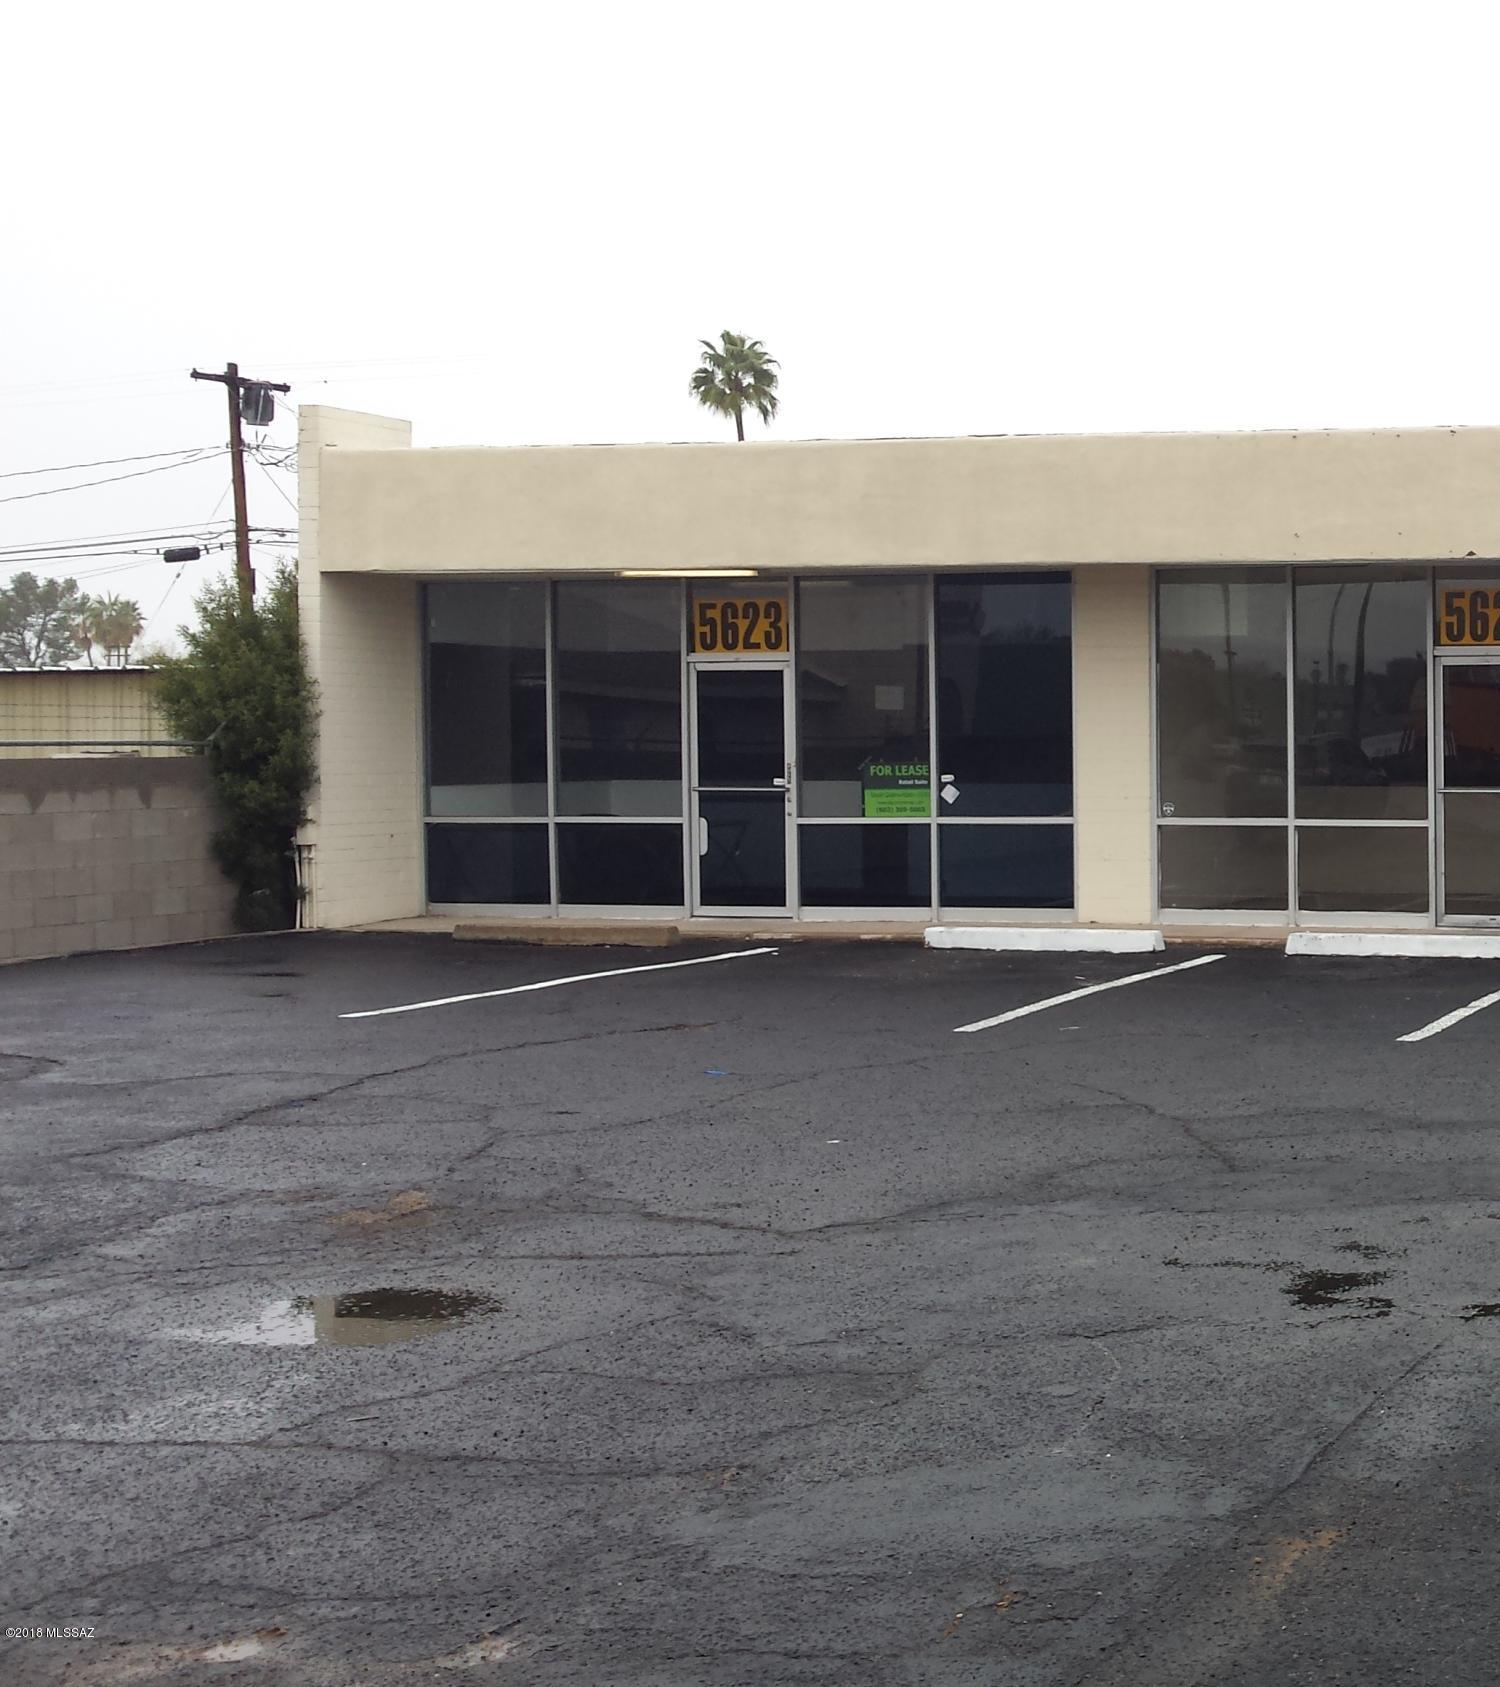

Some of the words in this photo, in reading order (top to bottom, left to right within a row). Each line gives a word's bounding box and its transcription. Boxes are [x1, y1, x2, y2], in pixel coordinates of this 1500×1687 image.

[699, 601, 783, 650] 5623
[870, 765, 892, 776] FOR
[895, 764, 929, 776] LEASE
